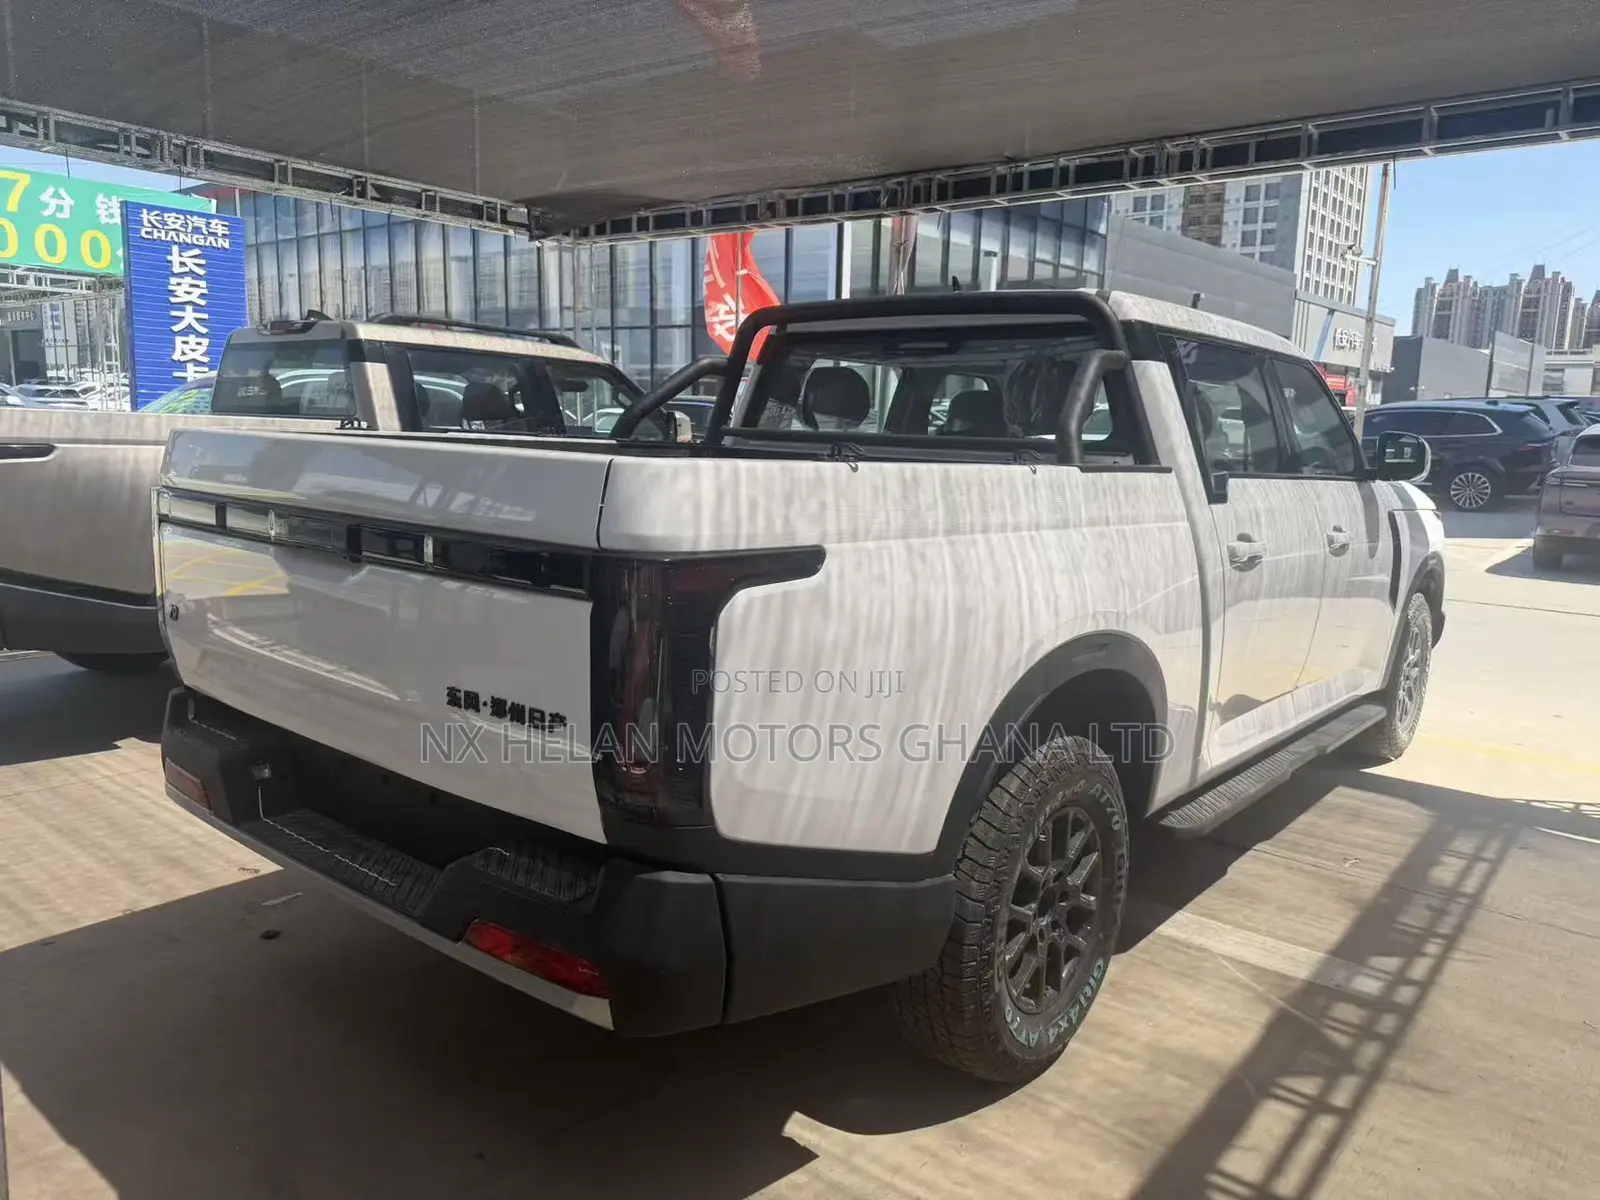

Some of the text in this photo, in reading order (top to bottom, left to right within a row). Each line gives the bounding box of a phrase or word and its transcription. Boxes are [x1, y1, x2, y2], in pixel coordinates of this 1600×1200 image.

[140, 208, 230, 236] 长安汽车
[140, 227, 230, 249] CHANGAN
